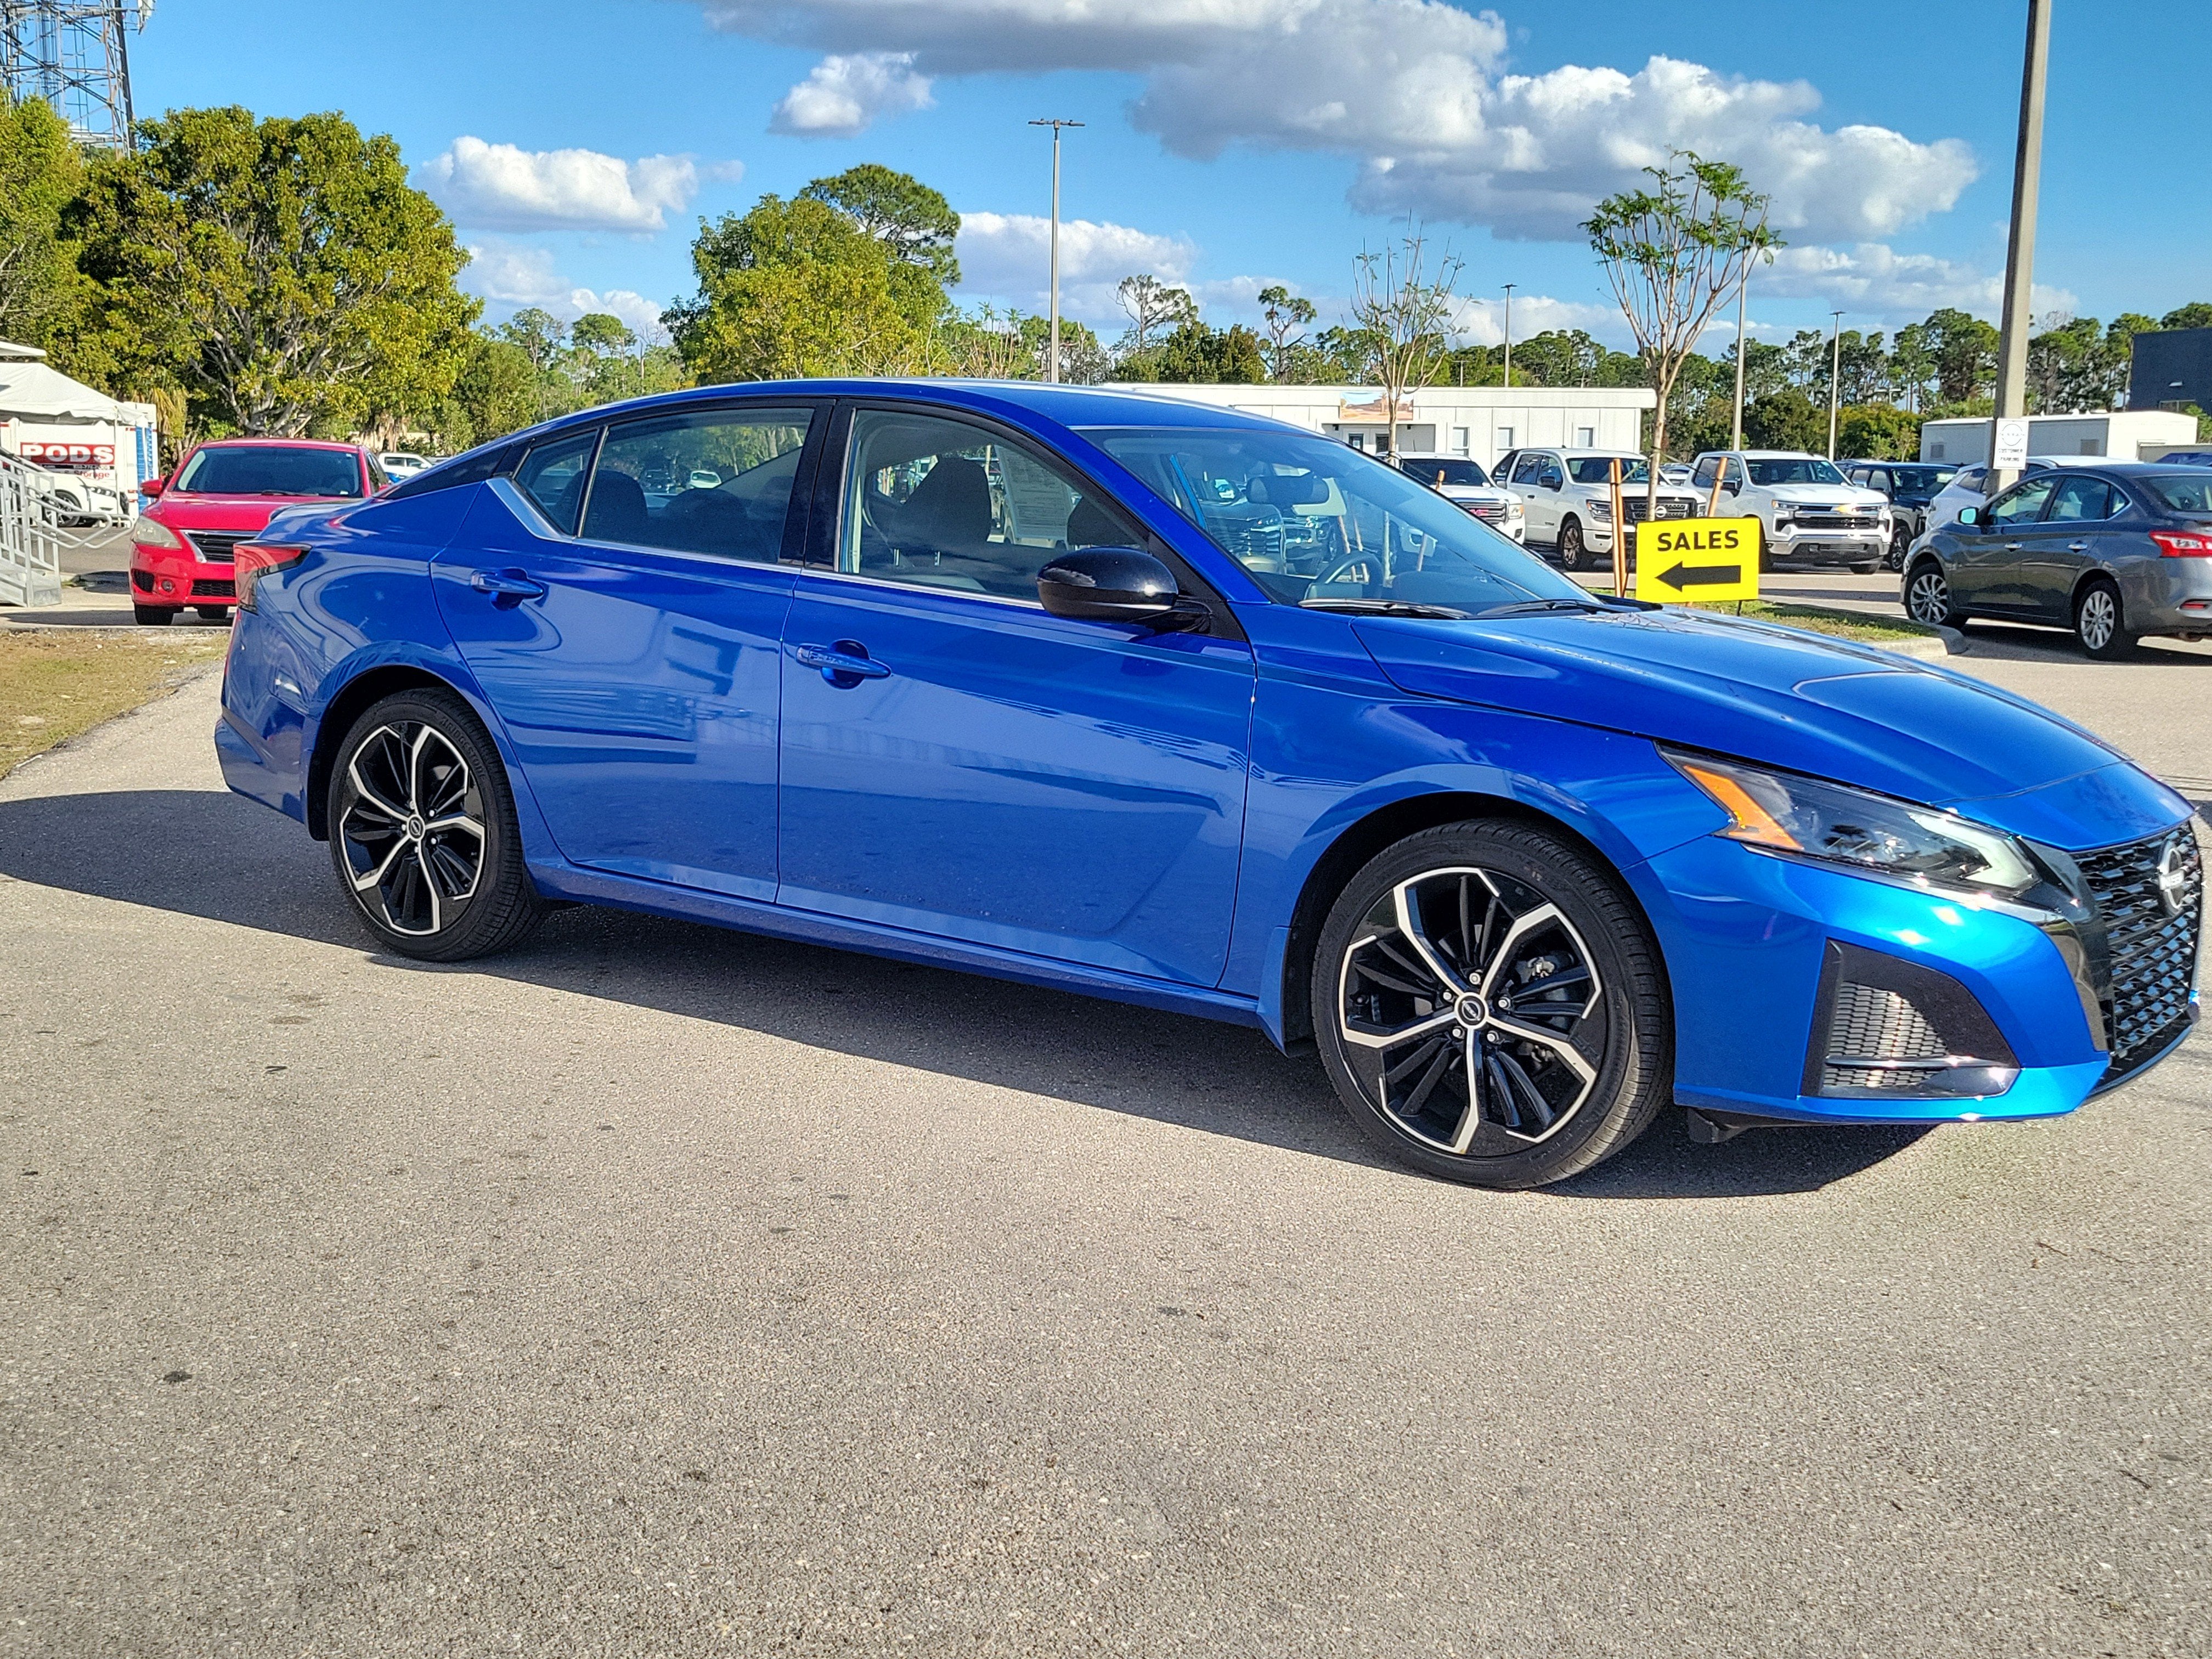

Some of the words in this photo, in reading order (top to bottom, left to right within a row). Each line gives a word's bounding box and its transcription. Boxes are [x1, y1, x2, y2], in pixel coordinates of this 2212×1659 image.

[22, 444, 114, 463] PODS
[74, 470, 110, 481] Storge
[1657, 529, 1739, 552] SALES
